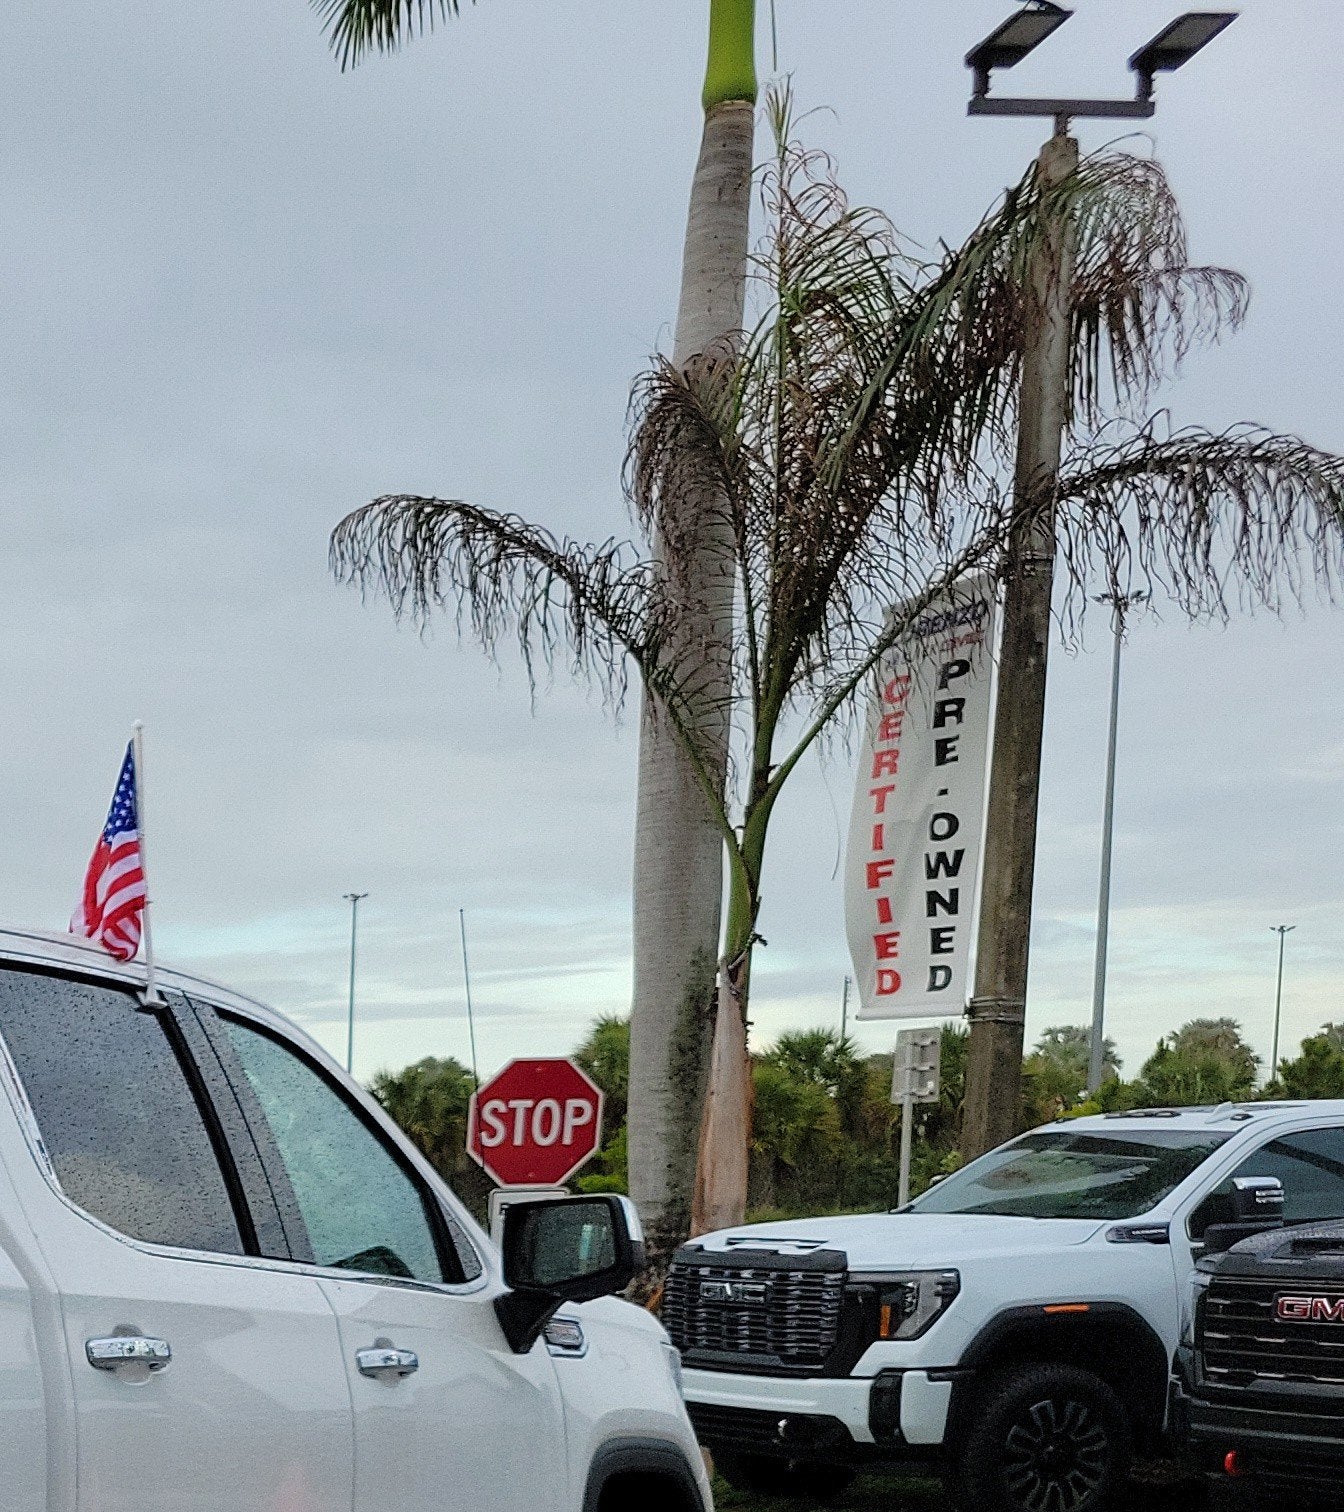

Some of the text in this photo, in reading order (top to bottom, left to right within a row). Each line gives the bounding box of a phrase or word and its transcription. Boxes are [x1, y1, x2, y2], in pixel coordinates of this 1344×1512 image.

[865, 674, 912, 997] CERTIFIED
[924, 659, 971, 993] PRE-OWNED
[480, 1098, 594, 1148] STOP
[1277, 1296, 1344, 1321] GM
